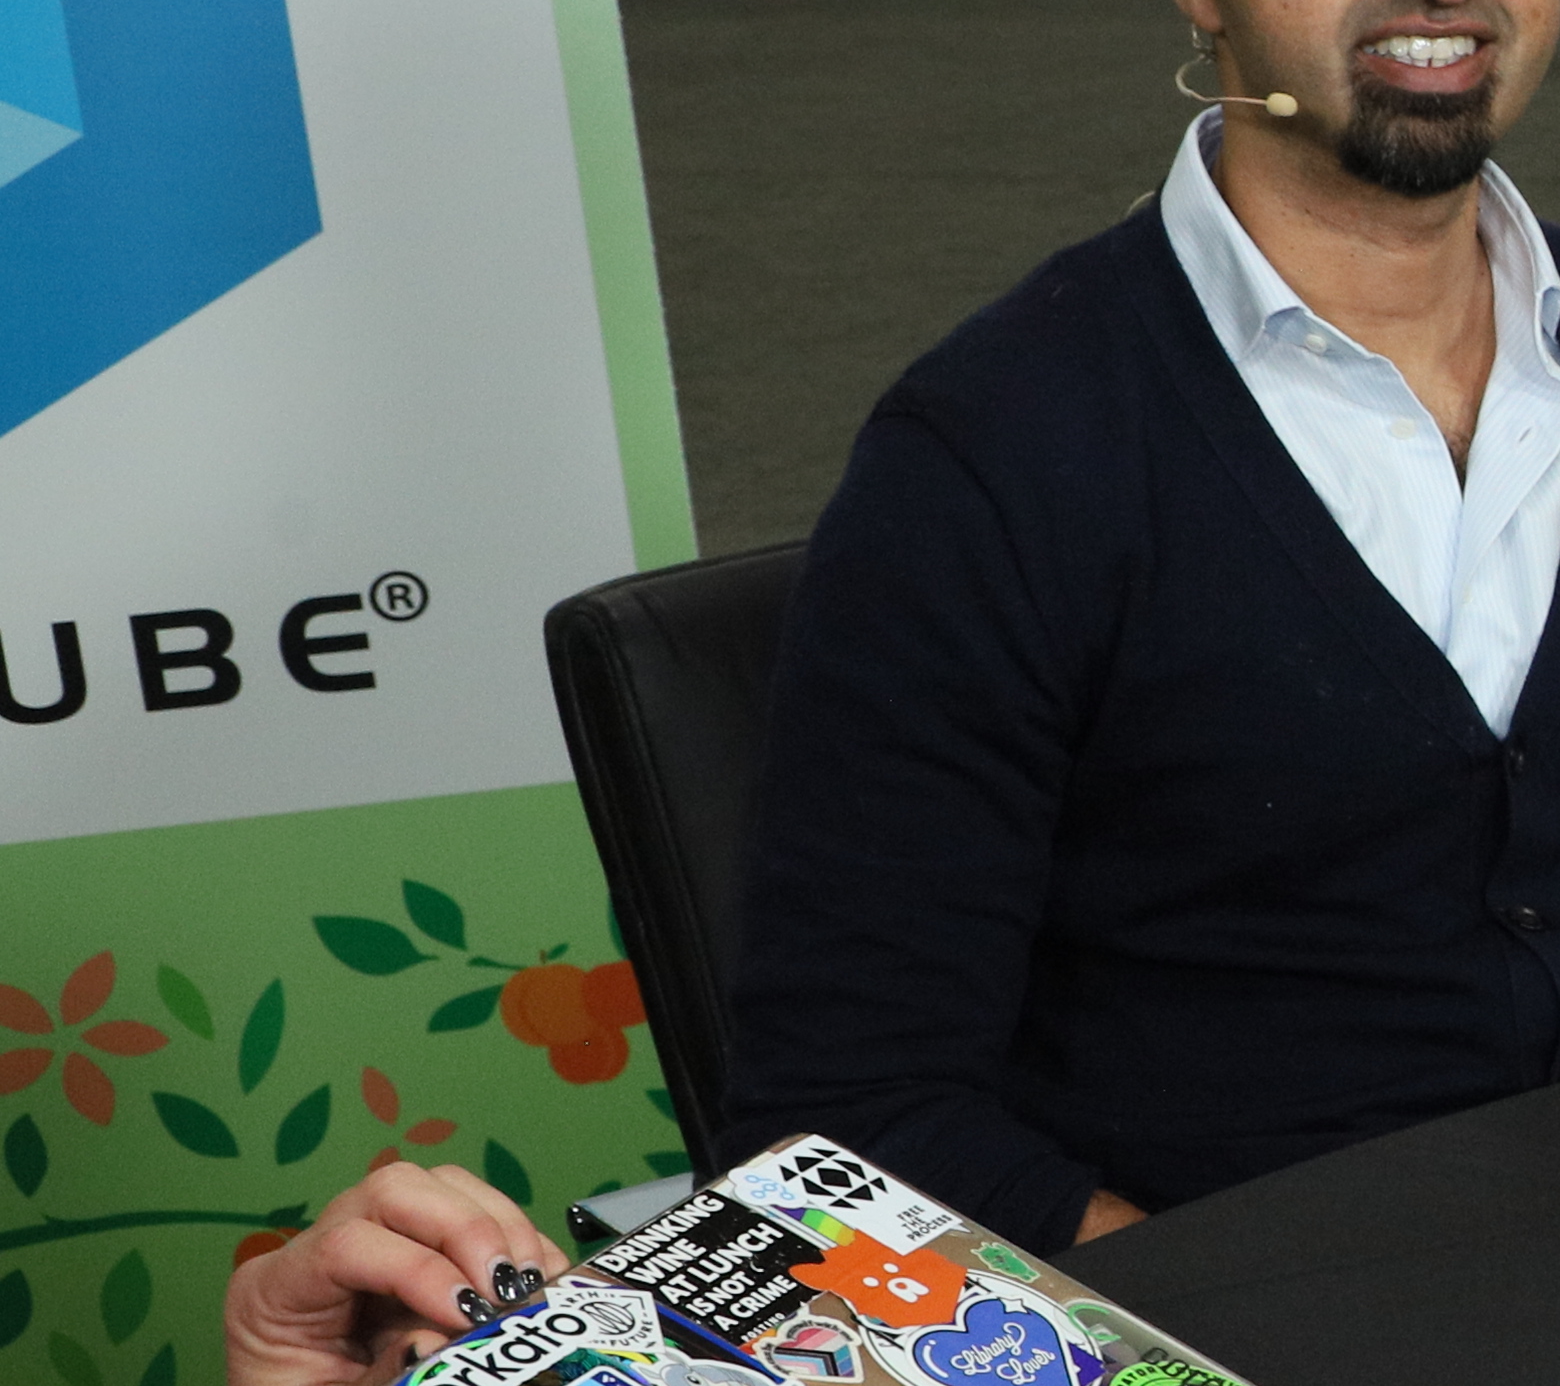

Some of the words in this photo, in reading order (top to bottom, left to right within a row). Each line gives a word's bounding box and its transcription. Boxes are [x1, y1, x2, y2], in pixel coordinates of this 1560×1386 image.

[594, 1192, 726, 1275] DRINKING
[897, 1204, 925, 1222] FREE
[901, 1215, 930, 1233] THE
[906, 1213, 953, 1243] PROCESS
[625, 1235, 706, 1286] WINE
[657, 1265, 702, 1307] AT
[695, 1221, 785, 1283] LUNCH
[685, 1296, 716, 1318] IS
[704, 1269, 755, 1306] NOT
[713, 1313, 740, 1333] A
[729, 1274, 798, 1319] CRIME
[609, 1320, 653, 1347] FUTURE
[950, 1321, 1026, 1376] Library
[995, 1347, 1056, 1386] Lover
